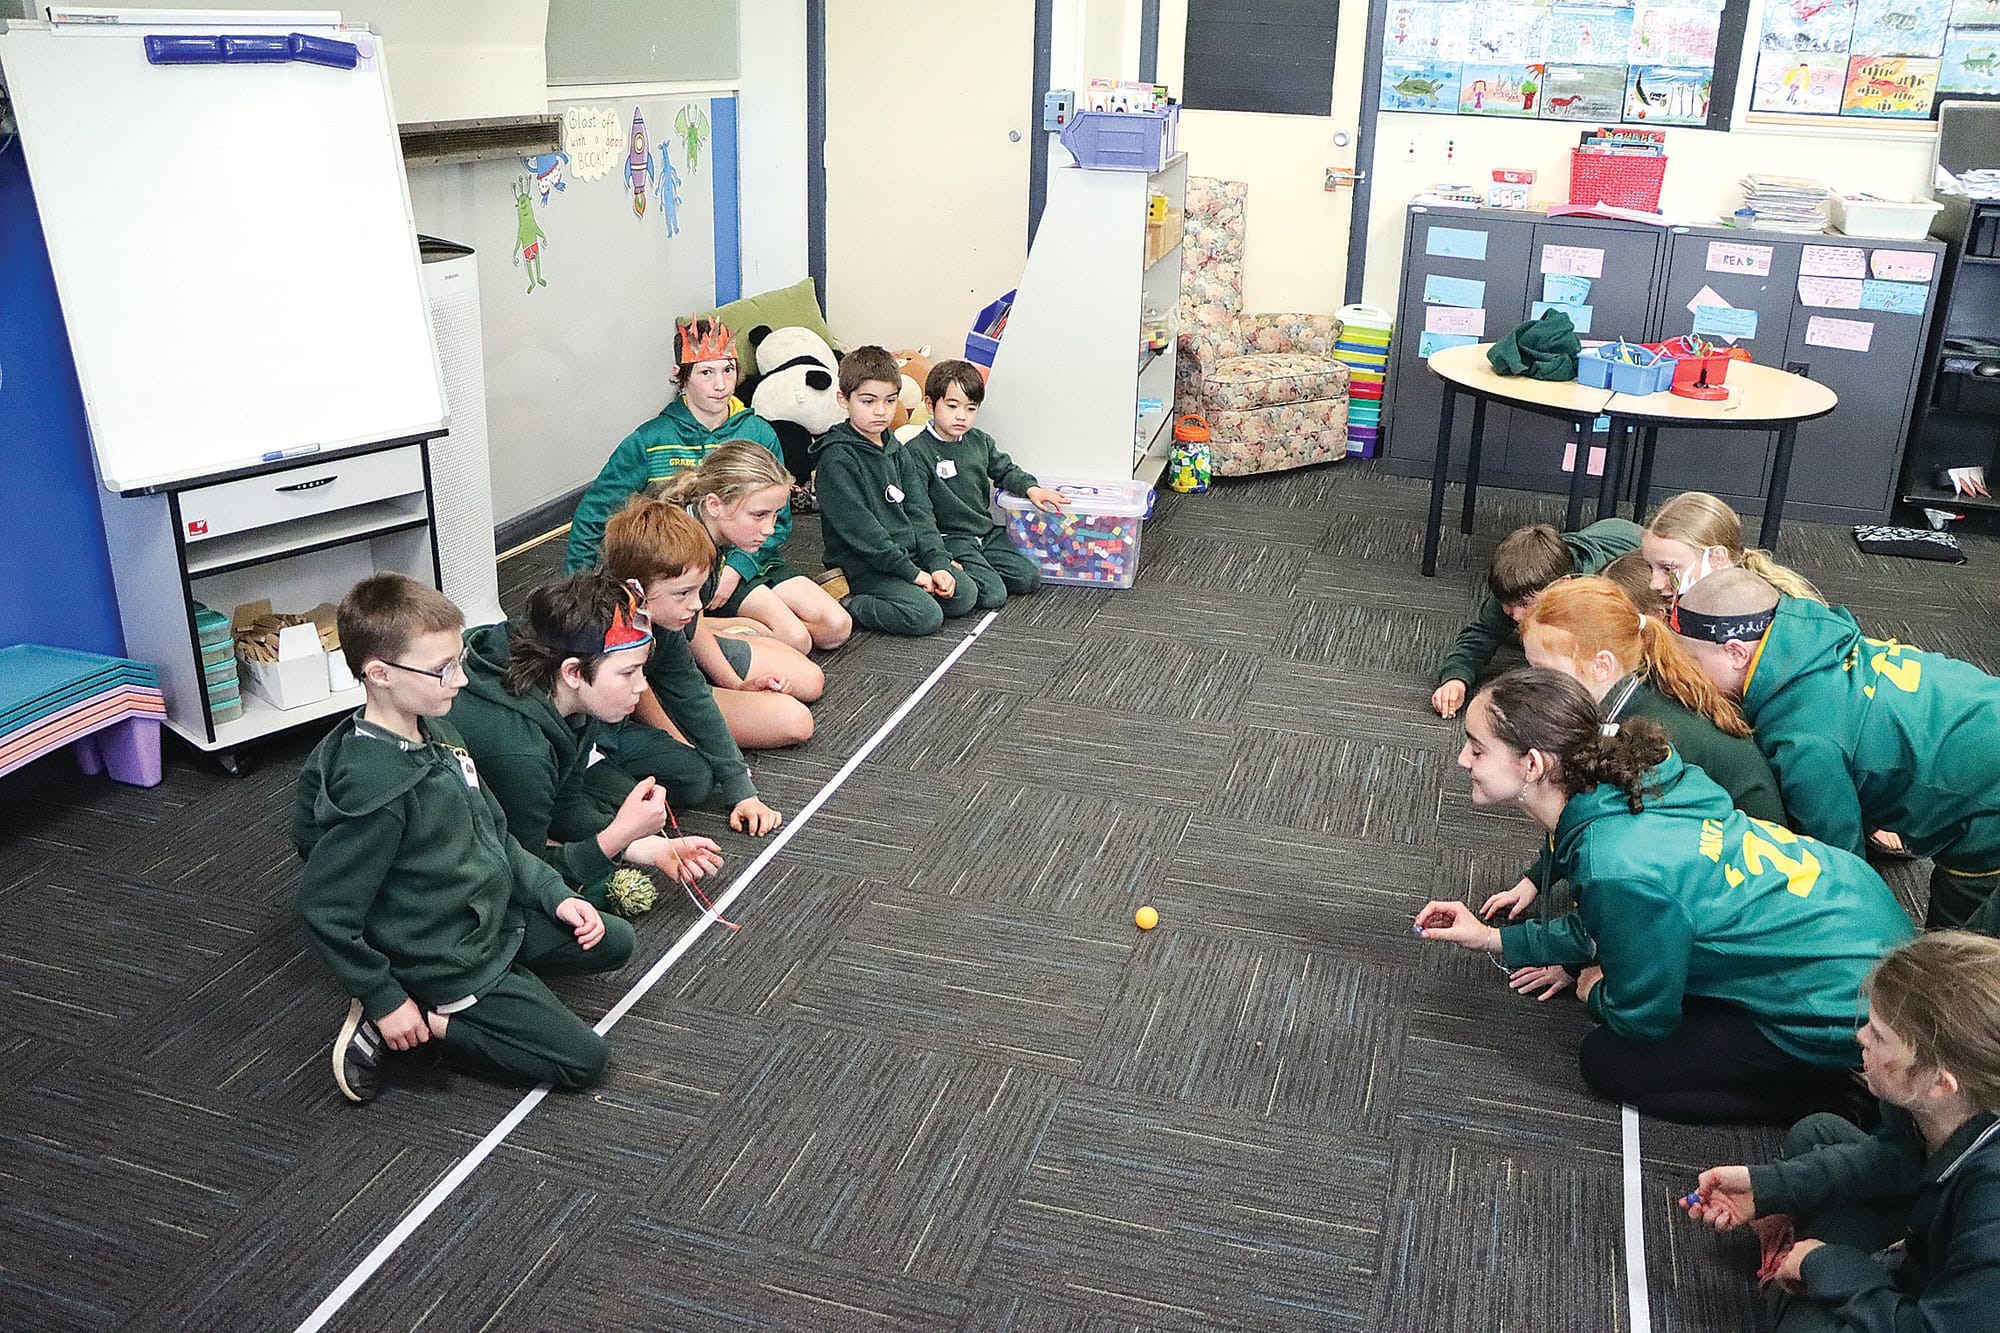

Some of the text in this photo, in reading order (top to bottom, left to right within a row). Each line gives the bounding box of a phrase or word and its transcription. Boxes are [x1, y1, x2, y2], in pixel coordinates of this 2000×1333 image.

[569, 110, 616, 137] Blast off
[570, 134, 586, 146] with
[605, 133, 623, 154] good
[577, 151, 605, 170] BOOK!
[1722, 254, 1754, 266] READ
[669, 457, 697, 467] GRADE
